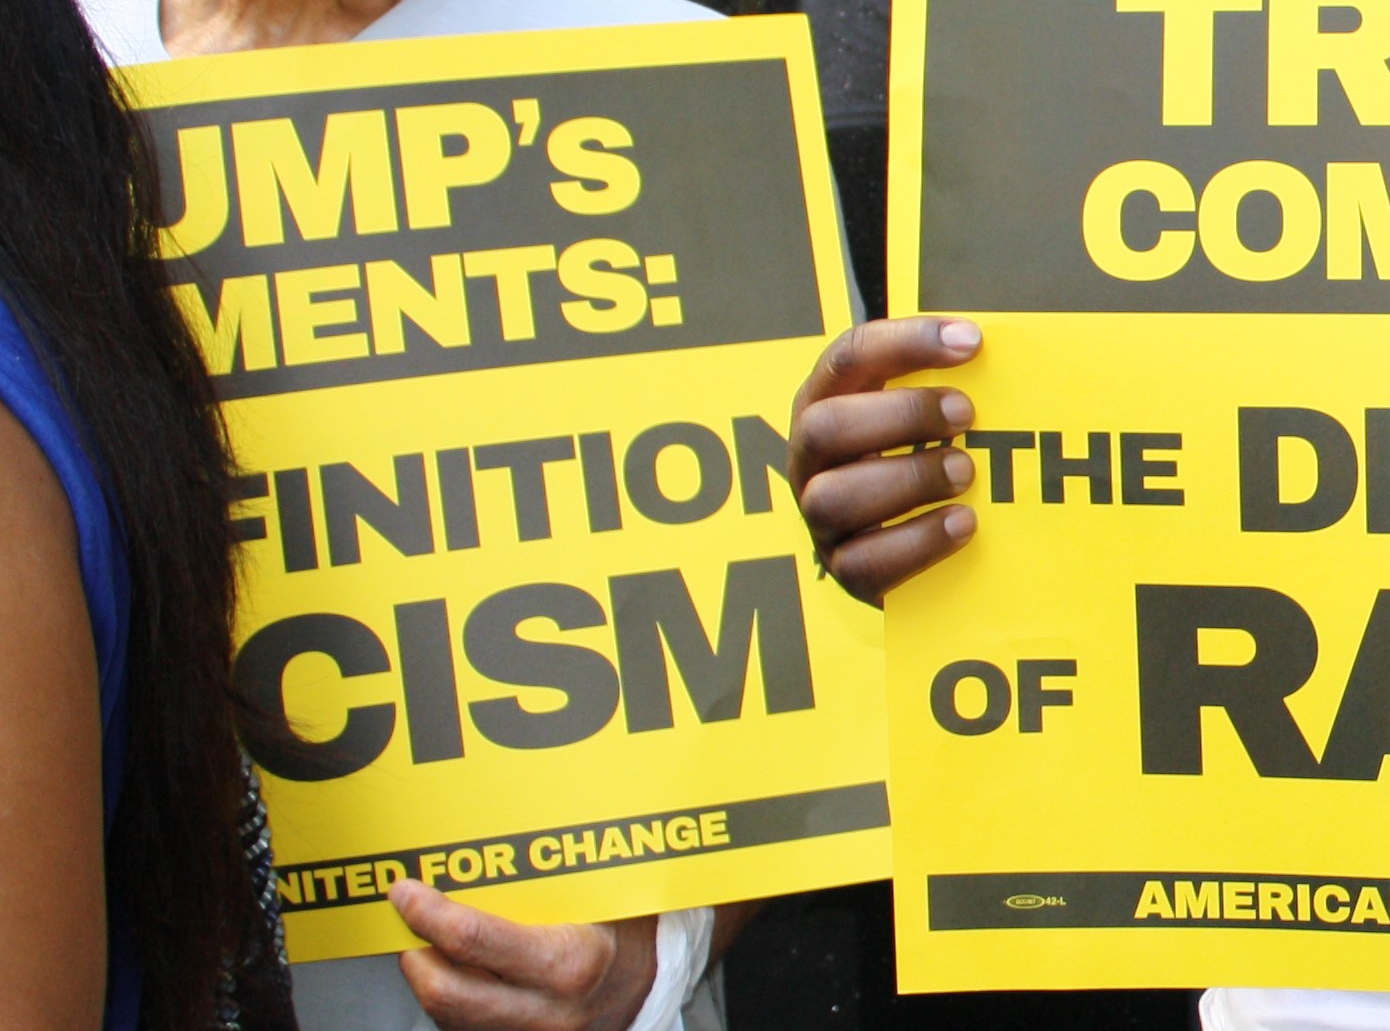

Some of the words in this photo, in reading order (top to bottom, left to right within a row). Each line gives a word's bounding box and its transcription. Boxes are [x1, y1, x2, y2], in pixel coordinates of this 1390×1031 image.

[148, 96, 643, 261] UMP’s
[165, 237, 685, 376] MENTS:
[228, 414, 791, 574] FINITION
[913, 429, 1186, 507] THE
[234, 552, 826, 782] CISM
[928, 658, 1078, 737] OF
[275, 858, 407, 906] NITED
[419, 843, 518, 888] FOR
[528, 811, 731, 872] CHANGE
